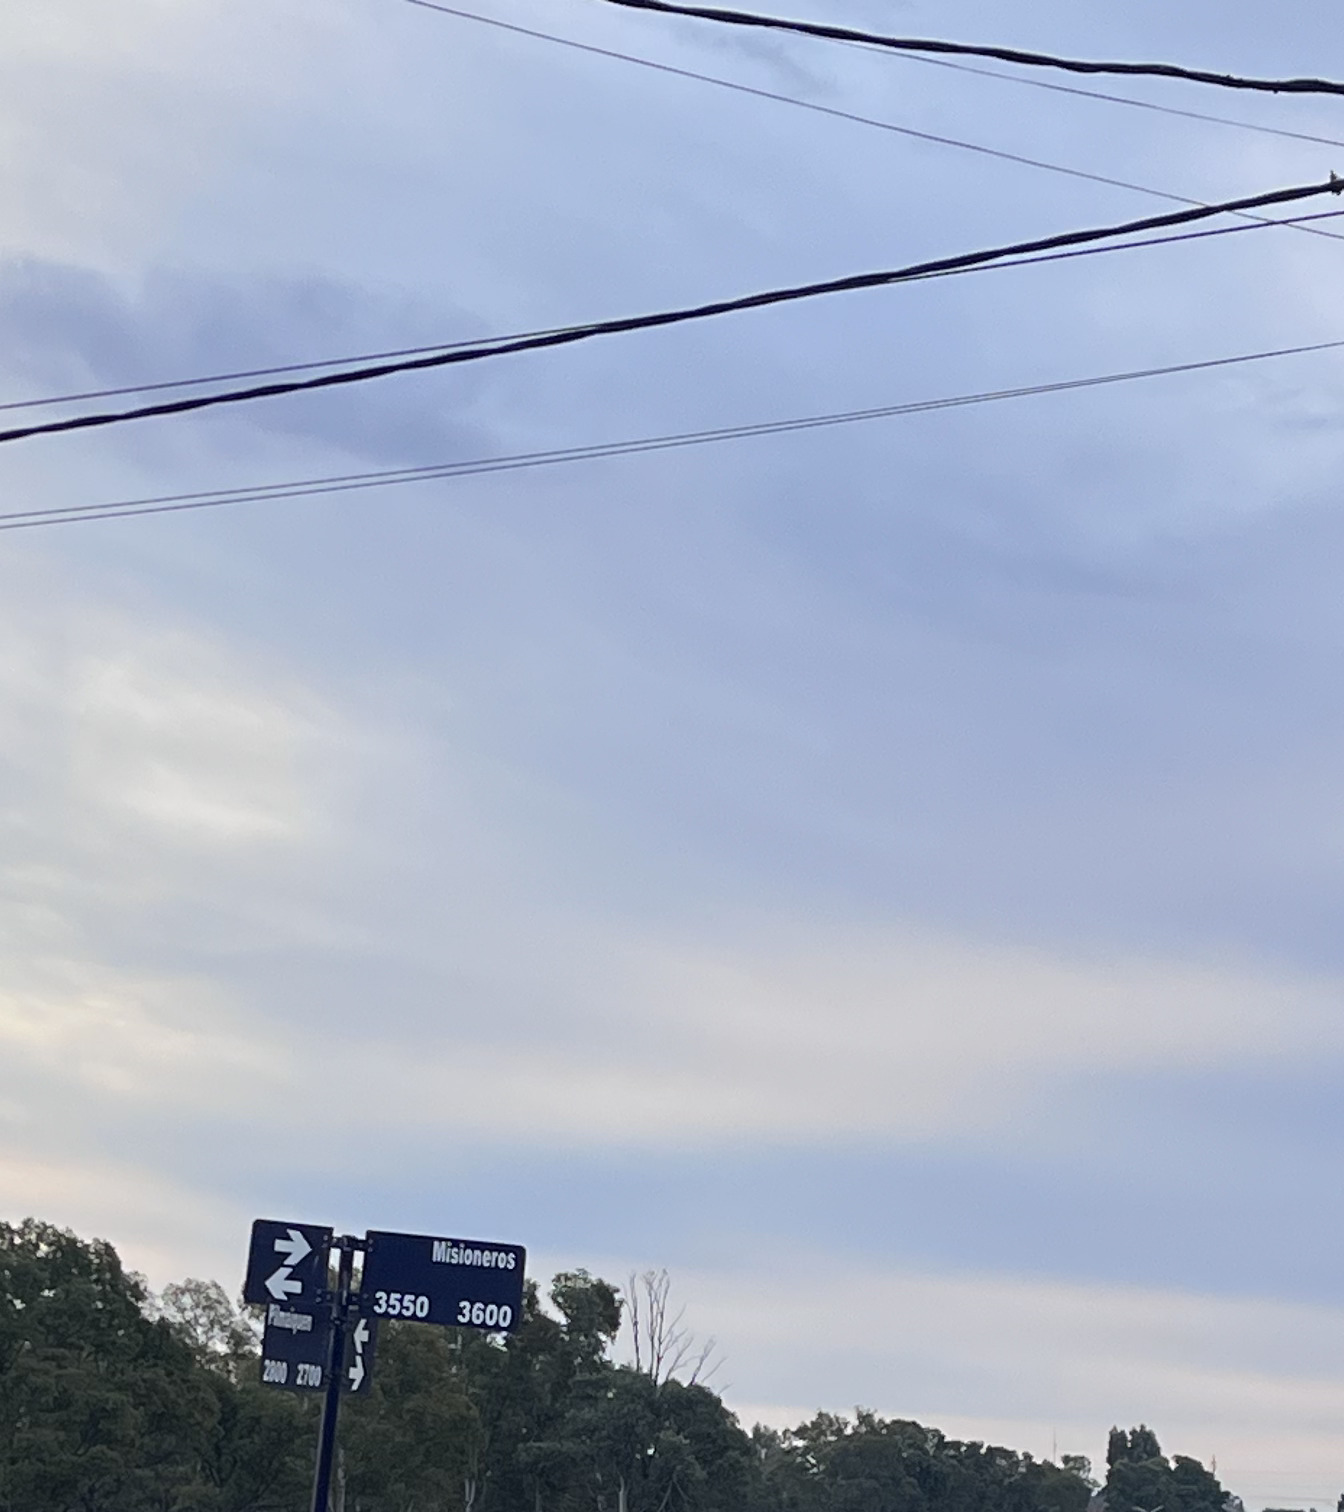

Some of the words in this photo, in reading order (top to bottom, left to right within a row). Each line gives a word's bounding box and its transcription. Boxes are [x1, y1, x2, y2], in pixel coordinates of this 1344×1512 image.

[431, 1240, 516, 1270] Misioneros
[373, 1291, 430, 1318] 3550
[457, 1300, 513, 1328] 3600
[296, 1363, 322, 1388] 2700
